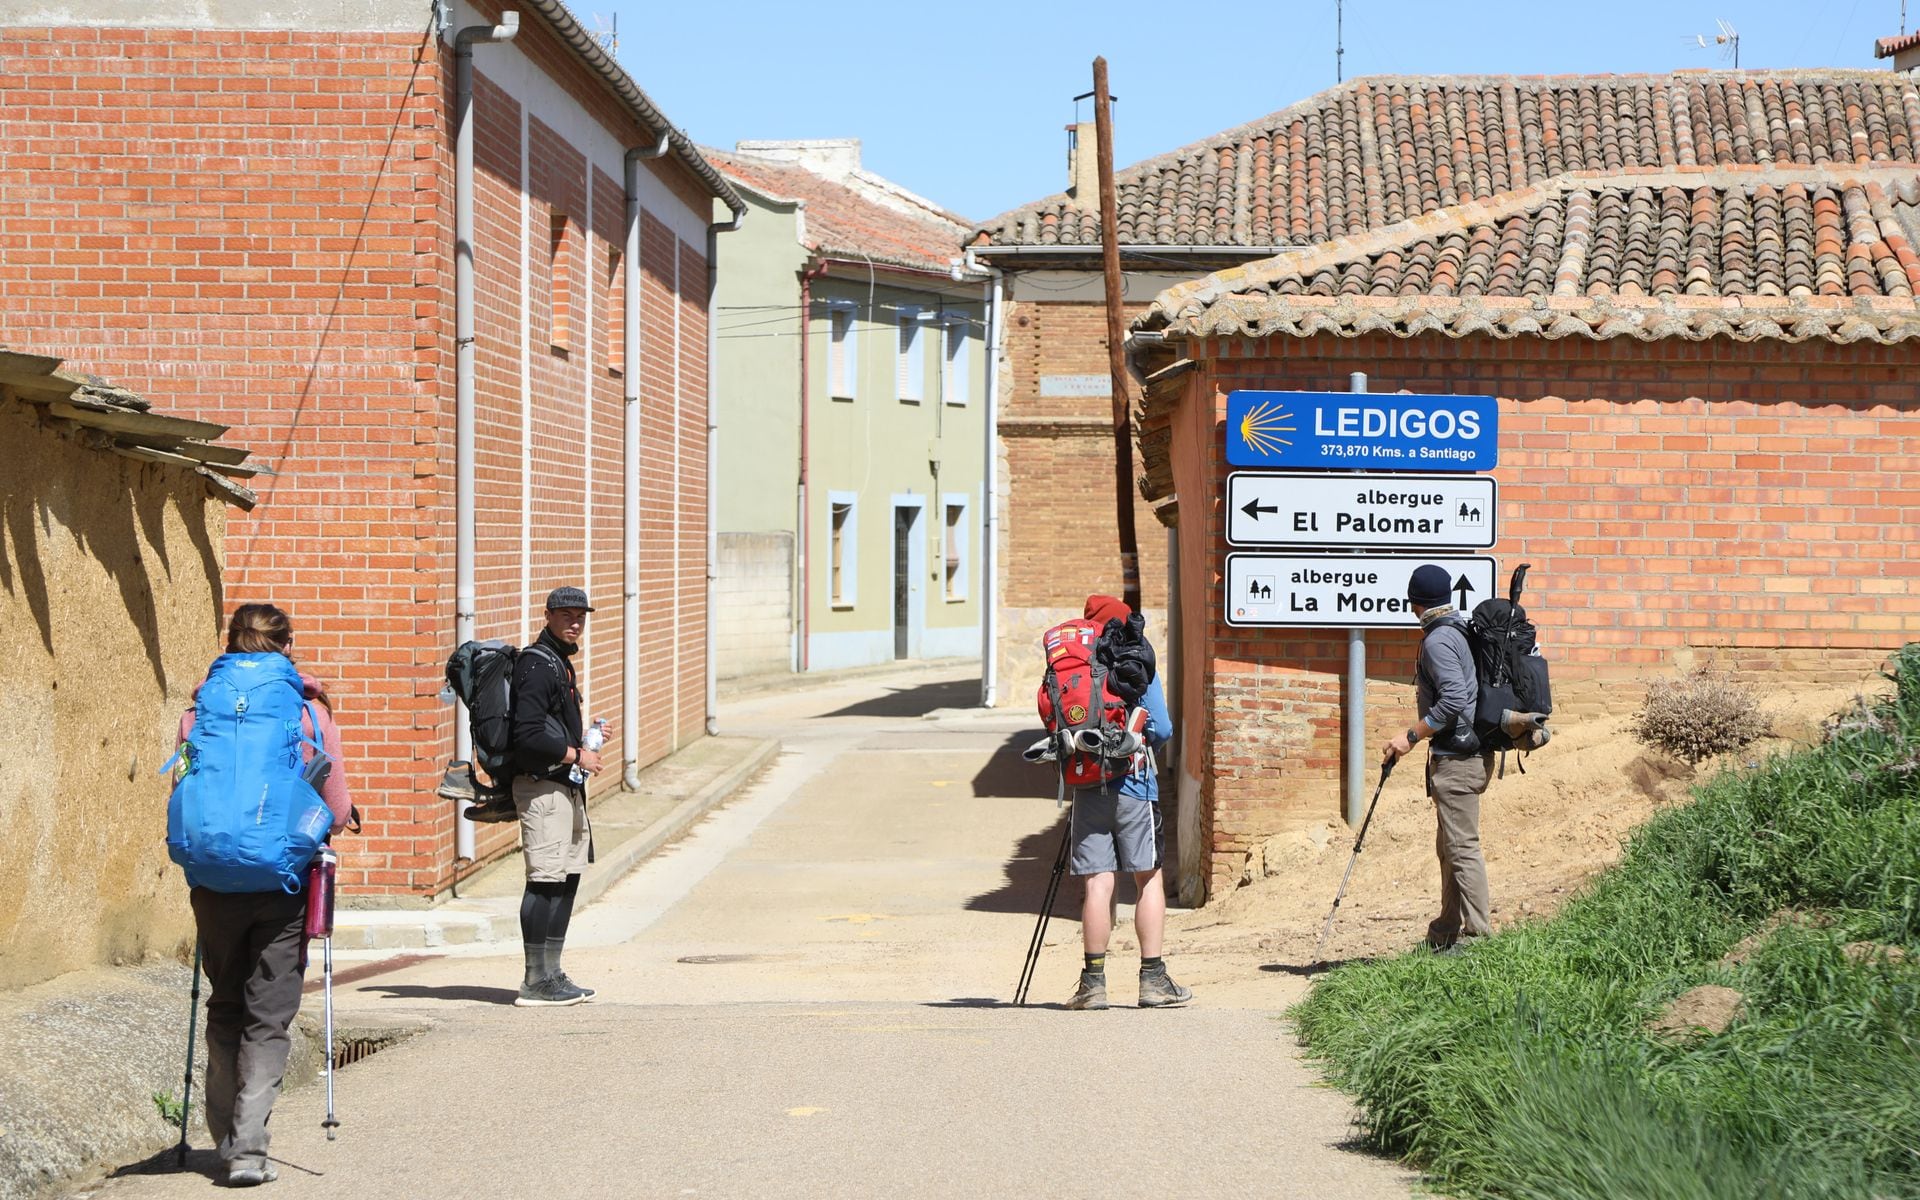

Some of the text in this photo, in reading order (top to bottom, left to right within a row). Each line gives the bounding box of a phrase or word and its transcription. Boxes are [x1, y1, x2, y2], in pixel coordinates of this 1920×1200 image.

[1315, 407, 1481, 440] LEDIGOS
[1320, 444, 1476, 462] 373,870 Kms. a Santiago
[1356, 489, 1444, 509] albergue
[1293, 512, 1444, 534] El Palomar
[1291, 569, 1378, 588] albergue
[1290, 592, 1415, 614] La Moren
